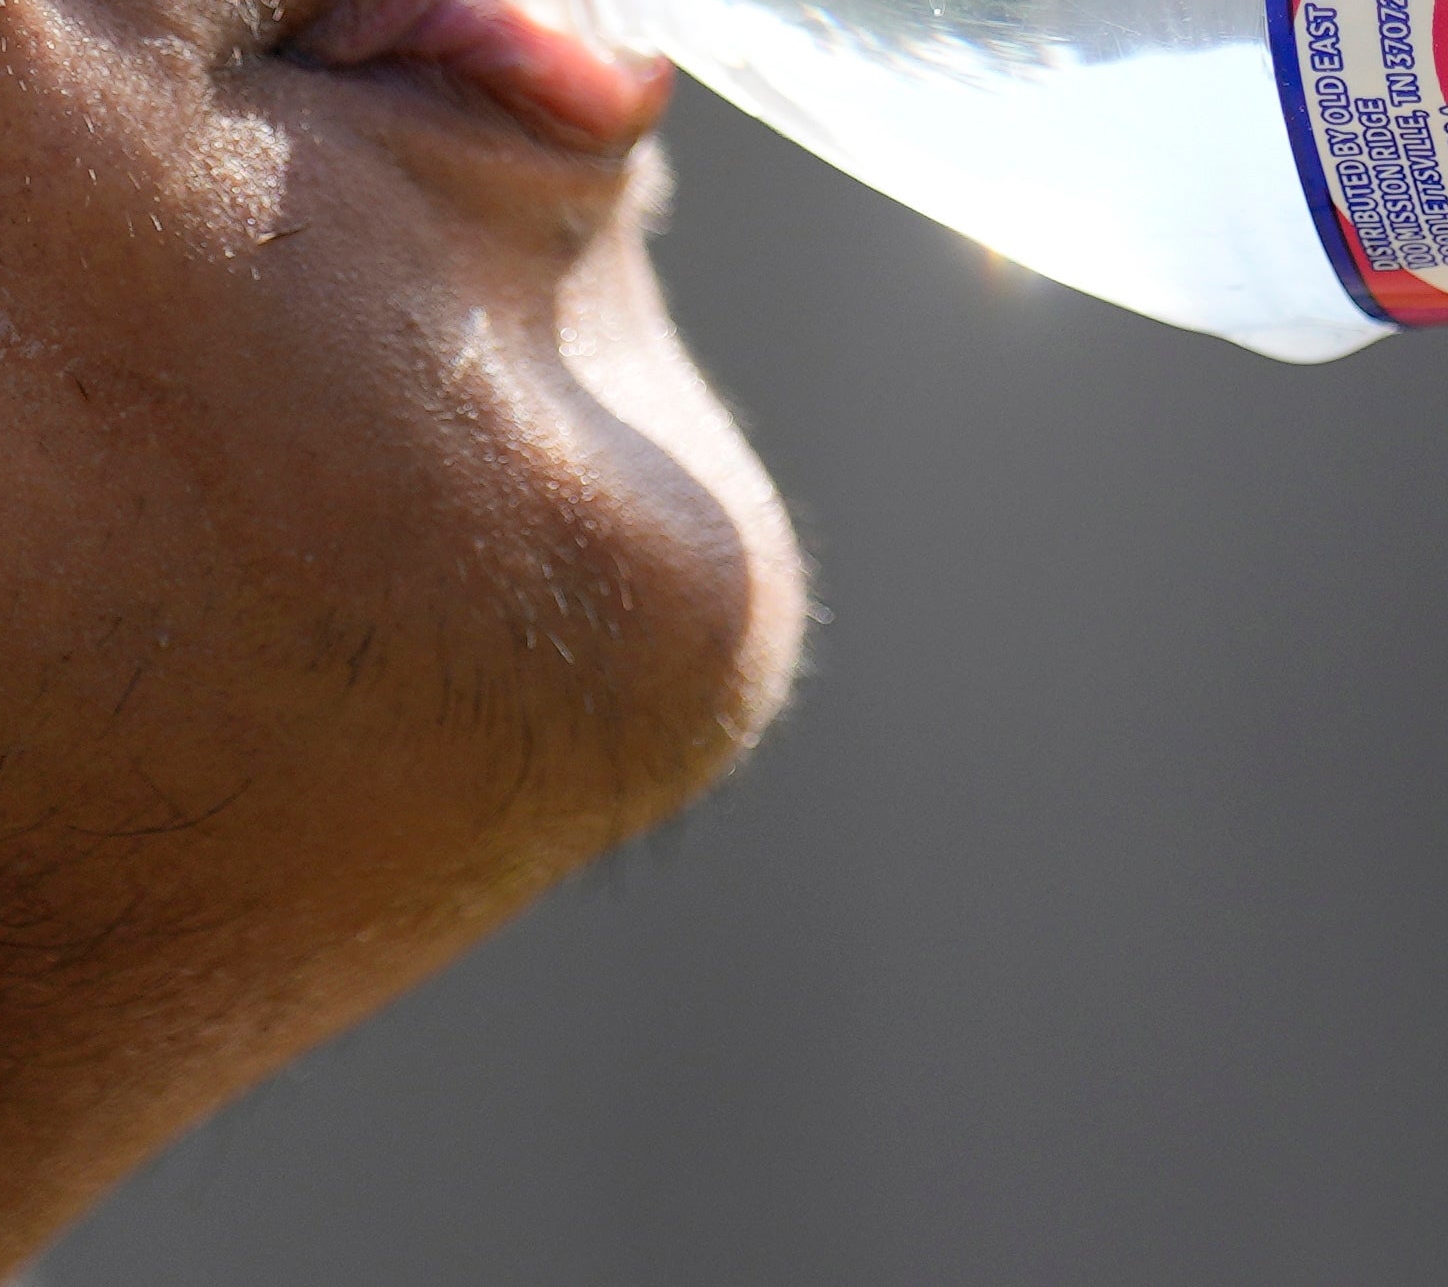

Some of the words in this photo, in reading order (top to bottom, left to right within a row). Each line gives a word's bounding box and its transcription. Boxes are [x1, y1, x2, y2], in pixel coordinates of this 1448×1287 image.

[1304, 3, 1343, 71] EAST
[1316, 75, 1352, 123] OLD
[1386, 74, 1420, 106] TN
[1326, 128, 1362, 155] BY
[1355, 98, 1399, 159] RIDGE
[1336, 159, 1400, 271] DISTRIBUTED
[1373, 165, 1426, 240] MISSION
[1400, 243, 1436, 269] 100
